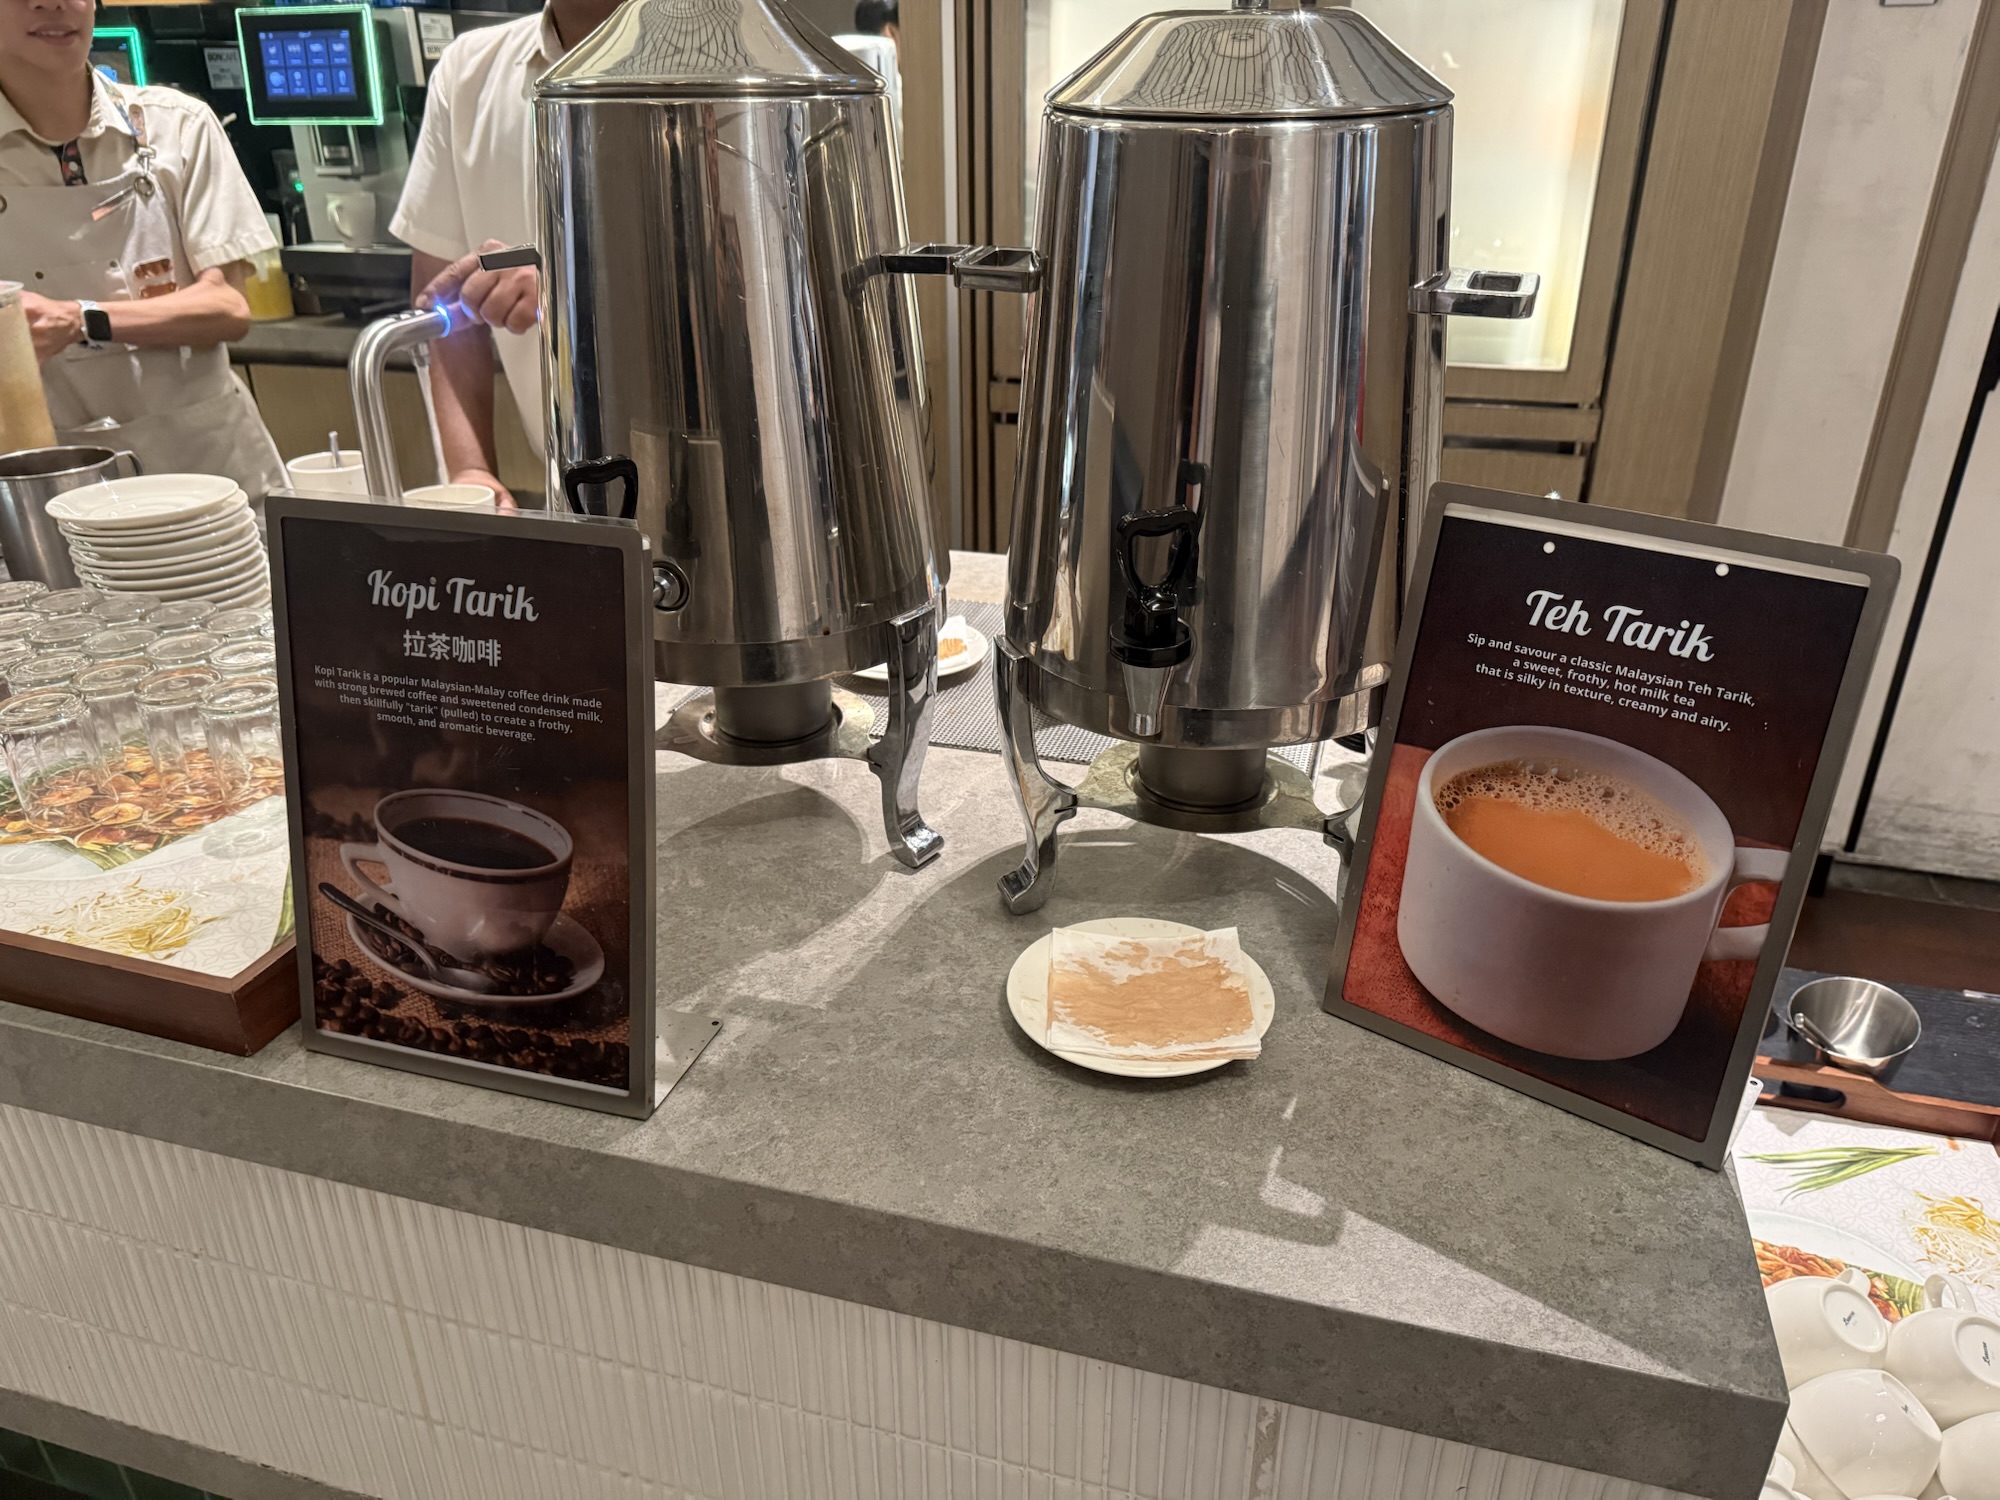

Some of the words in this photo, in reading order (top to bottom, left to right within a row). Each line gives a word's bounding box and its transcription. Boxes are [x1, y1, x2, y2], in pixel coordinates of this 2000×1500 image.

[367, 569, 440, 620] Kopi
[446, 577, 539, 622] Tarik
[403, 629, 502, 668] 拉茶咖啡
[1526, 590, 1592, 636] Teh
[1603, 605, 1715, 662] Tarik
[314, 665, 335, 678] Kopi
[337, 667, 361, 680] Tarik
[363, 671, 372, 680] is
[373, 673, 379, 681] a
[381, 675, 419, 687] popular
[421, 678, 505, 699] Malaysian-Malay
[507, 689, 540, 701] coffee
[542, 692, 570, 705] drink
[572, 697, 603, 709] made
[1467, 633, 1486, 648] Sip
[1488, 639, 1512, 651] and
[1514, 644, 1557, 661] savour
[1559, 655, 1567, 664] a
[1570, 656, 1613, 674] classic
[1615, 665, 1684, 689] Malaysian
[1687, 680, 1713, 696] Teh
[1716, 686, 1756, 707] Tarik,
[1512, 659, 1521, 668] a
[1523, 661, 1563, 679] sweet,
[1567, 668, 1610, 690] frothy,
[1613, 679, 1637, 694] hot
[1640, 688, 1670, 702] milk
[1673, 693, 1696, 708] tea
[314, 679, 336, 689] with
[337, 682, 368, 695] strong
[370, 684, 405, 698] brewed
[407, 690, 438, 702] coffee
[440, 695, 459, 705] and
[461, 697, 516, 712] sweetened
[518, 705, 574, 719] condensed
[577, 711, 603, 724] milk,
[340, 694, 361, 705] then
[363, 697, 404, 713] skillfully
[406, 702, 438, 715] "tarik"
[440, 706, 479, 722] (pulled)
[481, 712, 492, 722] to
[494, 715, 526, 726] create
[529, 719, 536, 727] a
[538, 719, 573, 734] frothy,
[1475, 663, 1502, 678] that
[1504, 668, 1514, 680] is
[1516, 672, 1546, 690] silky
[1548, 679, 1561, 691] in
[1563, 683, 1614, 705] texture,
[1618, 697, 1669, 718] creamy
[1671, 709, 1698, 723] and
[1700, 716, 1731, 733] airy.
[377, 713, 416, 726] smooth,
[418, 718, 436, 728] and
[439, 722, 483, 734] aromatic
[486, 725, 536, 742] beverage.
